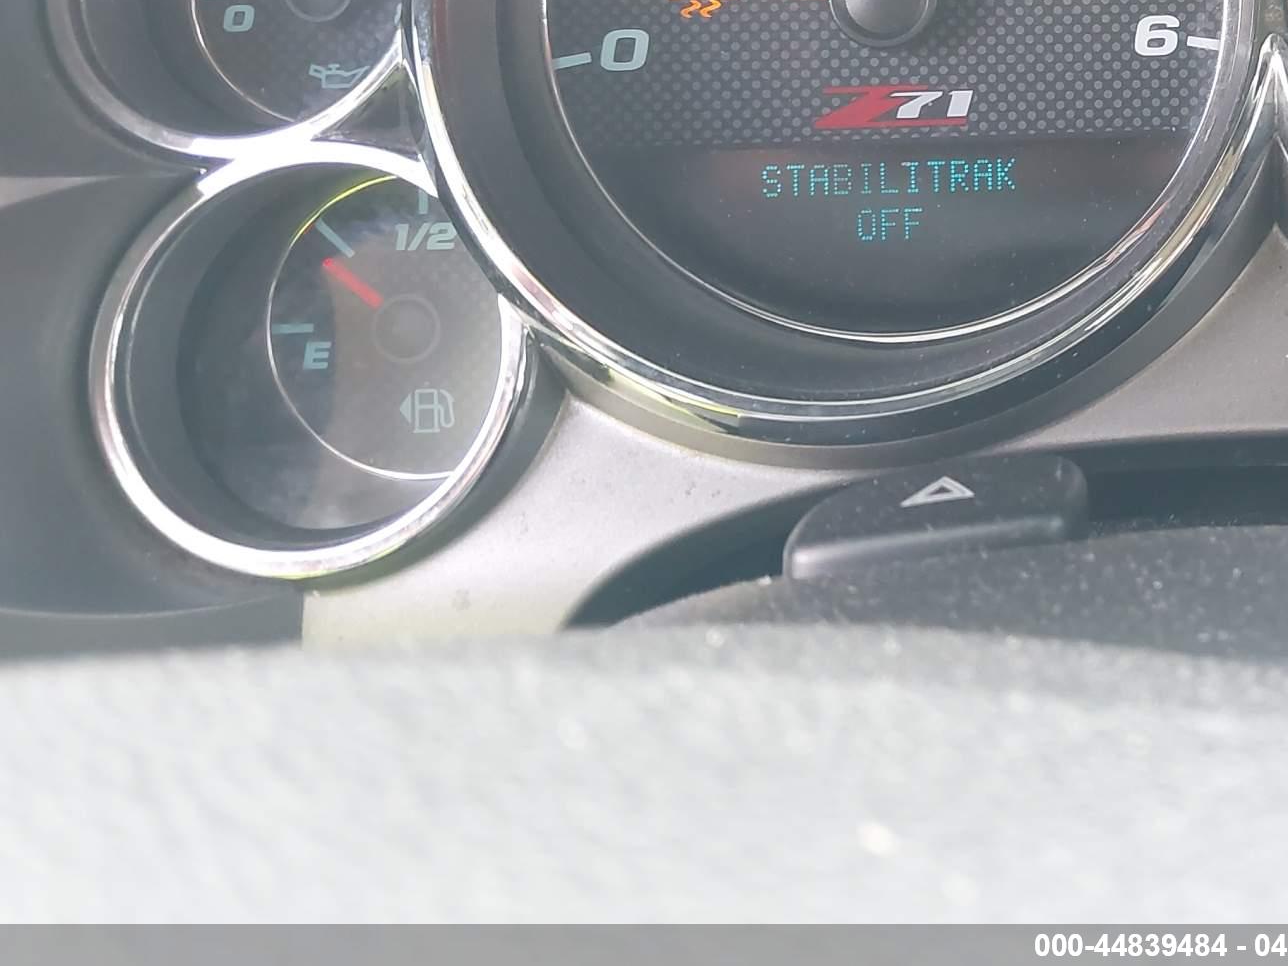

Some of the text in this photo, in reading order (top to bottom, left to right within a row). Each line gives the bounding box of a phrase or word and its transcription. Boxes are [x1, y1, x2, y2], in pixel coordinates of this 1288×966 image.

[223, 5, 254, 32] 0
[1135, 15, 1179, 56] 6
[600, 30, 648, 71] 0
[815, 86, 974, 129] Z71
[762, 158, 1016, 197] STABILITRAK
[395, 222, 457, 250] 1/2
[857, 208, 922, 240] OFF
[303, 342, 330, 368] E
